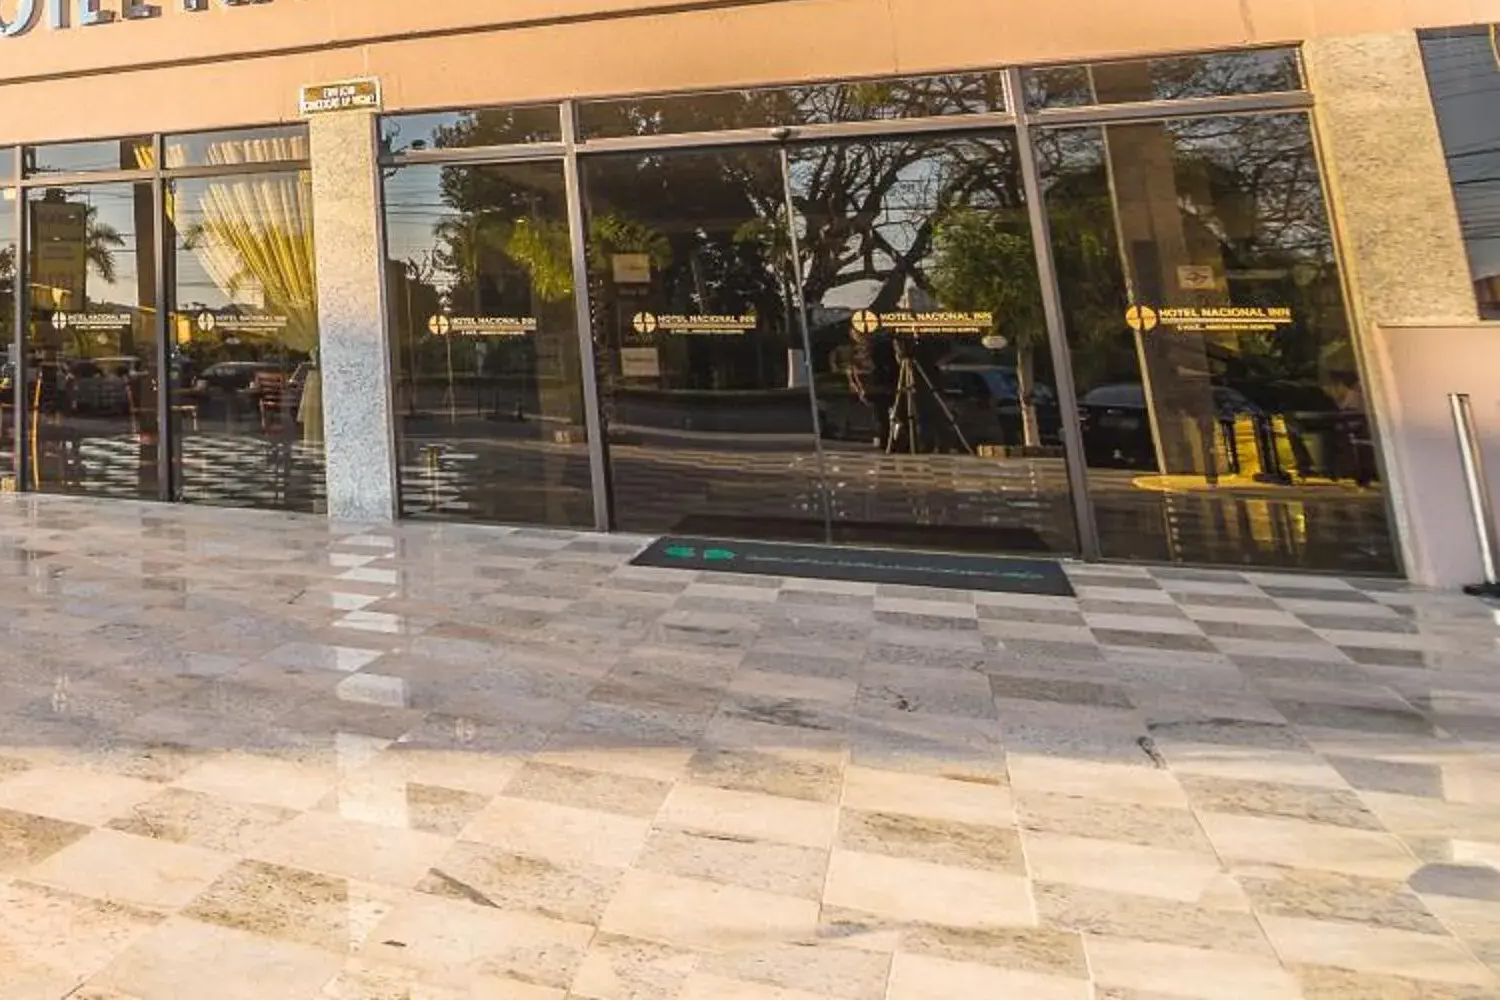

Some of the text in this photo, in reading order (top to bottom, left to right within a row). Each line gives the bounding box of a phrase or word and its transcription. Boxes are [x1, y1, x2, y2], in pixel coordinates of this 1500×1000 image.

[880, 311, 914, 321] HOTEL
[916, 311, 972, 321] NACIONAL
[1159, 307, 1200, 318] HOTEL
[1201, 307, 1266, 318] NACIONAL
